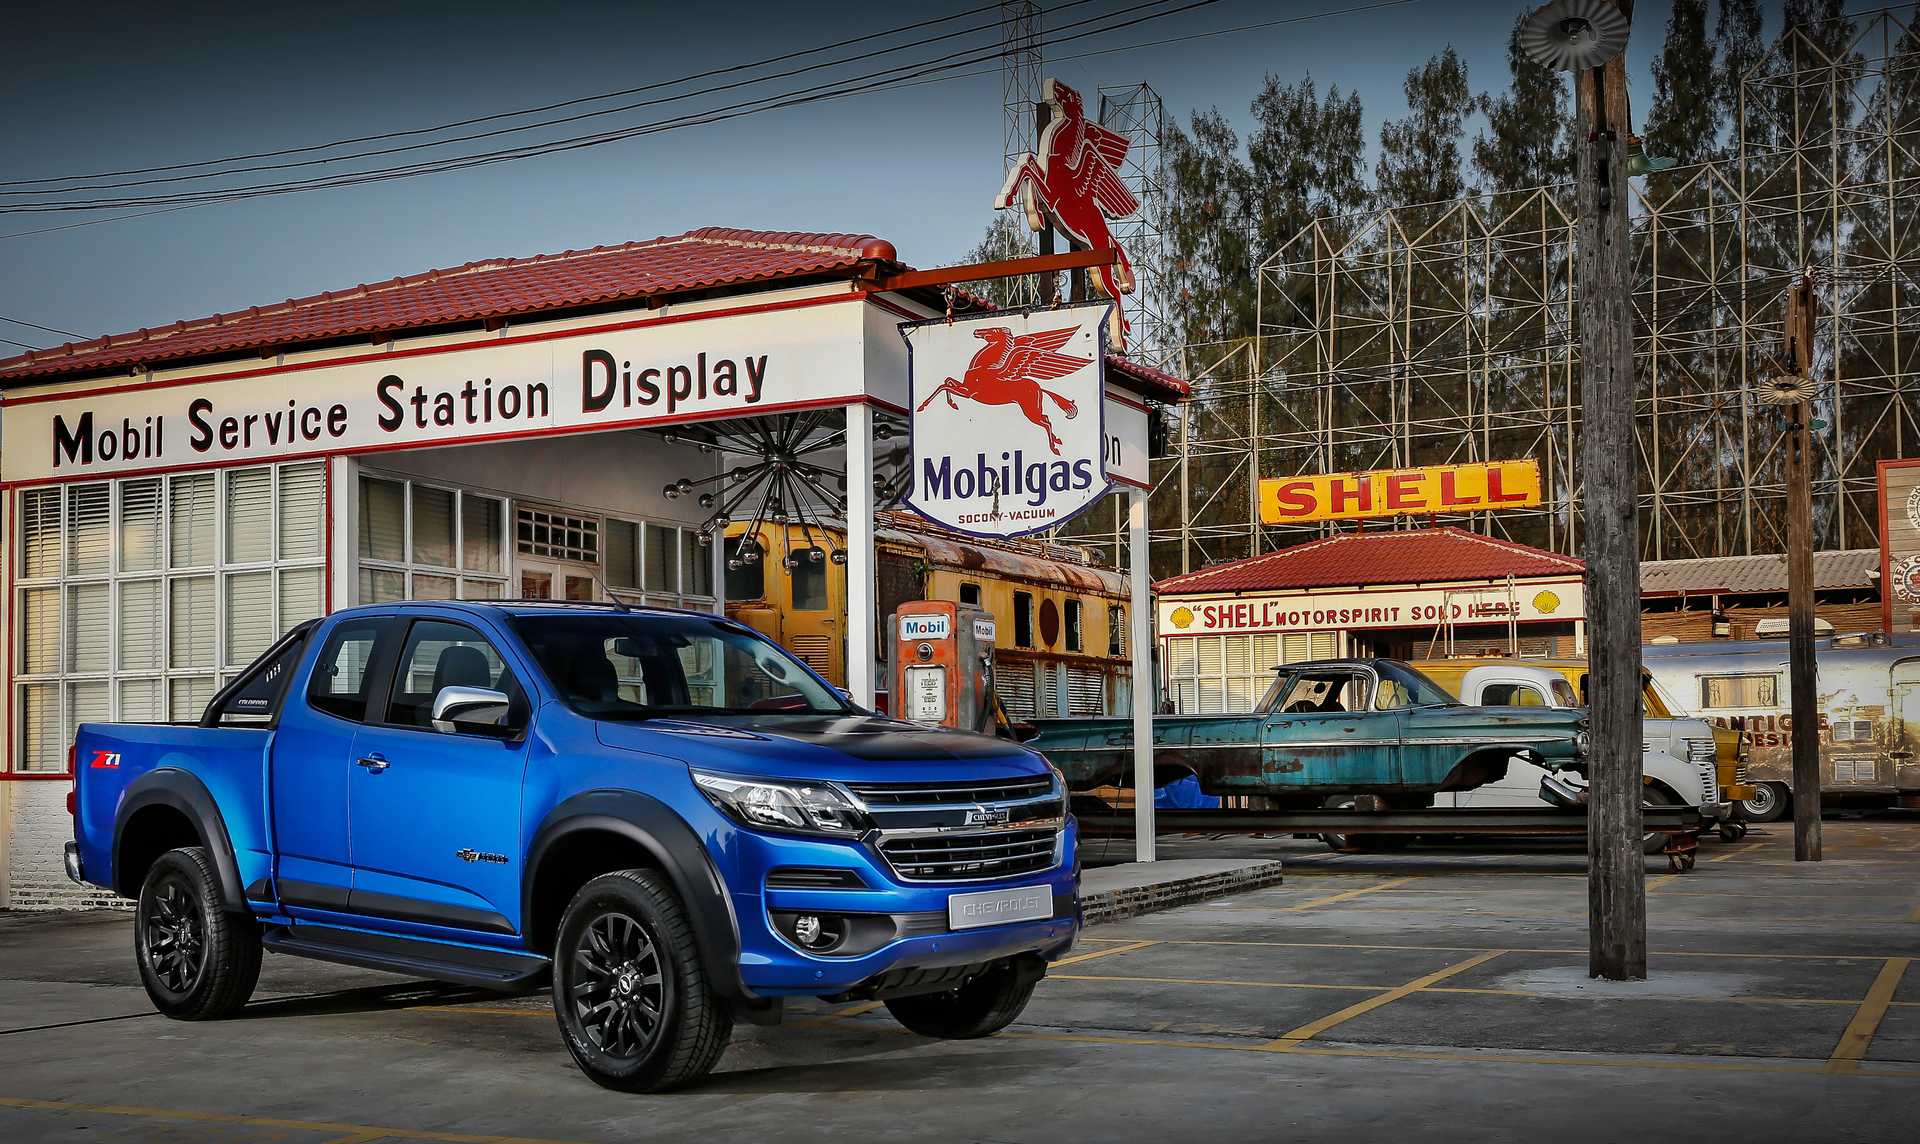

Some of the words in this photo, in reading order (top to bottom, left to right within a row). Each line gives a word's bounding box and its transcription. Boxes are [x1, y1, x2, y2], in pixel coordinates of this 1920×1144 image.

[53, 411, 163, 467] Mobil
[187, 398, 348, 453] Service
[376, 374, 549, 432] Station
[582, 349, 768, 414] Display
[923, 450, 1093, 506] Mobilgas
[1276, 467, 1529, 517] SHELL
[1275, 607, 1400, 626] MOTORSPIRIT
[906, 621, 945, 634] Mobil
[975, 625, 992, 636] Mobil
[90, 750, 121, 769] Z71
[963, 896, 1040, 917] CHEVROLET
